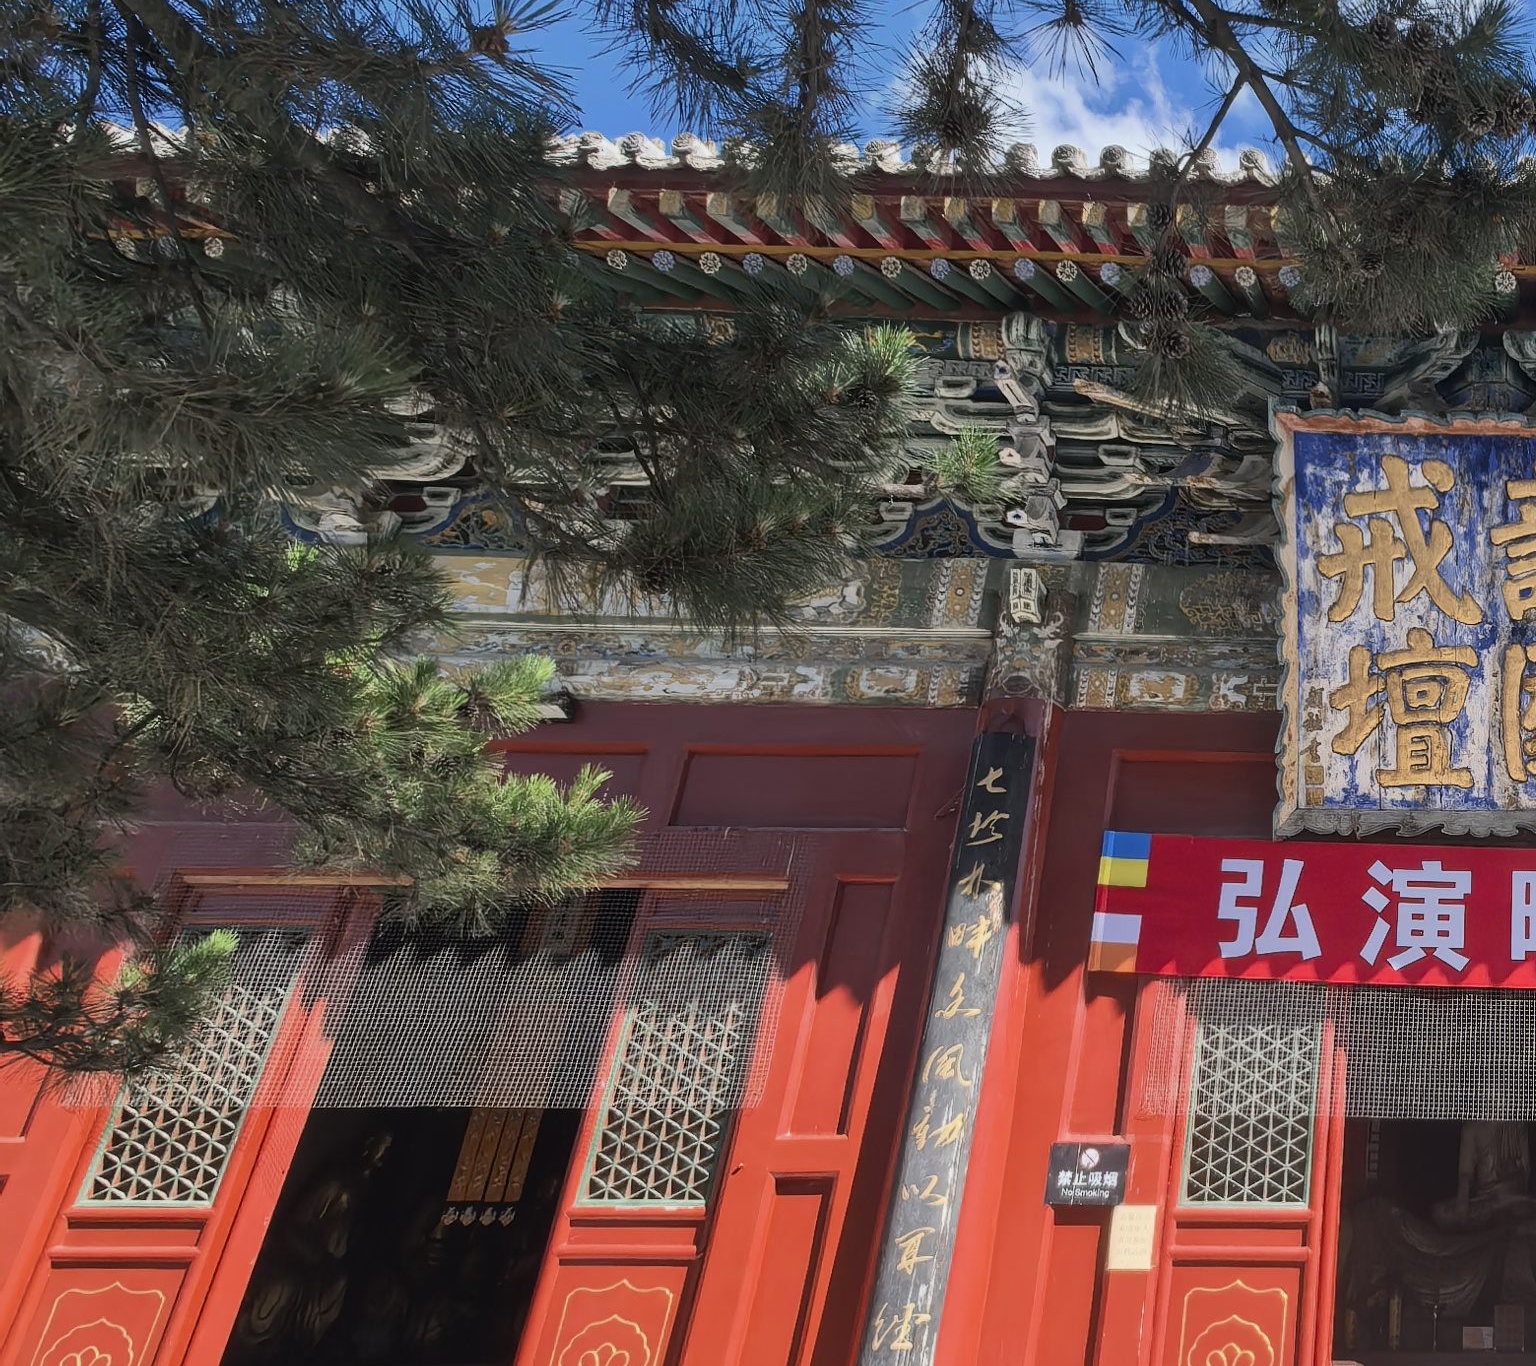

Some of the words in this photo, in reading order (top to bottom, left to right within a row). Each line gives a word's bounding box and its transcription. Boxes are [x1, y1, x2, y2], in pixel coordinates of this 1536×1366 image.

[1316, 453, 1483, 790] 戒壇
[1057, 1169, 1119, 1187] 禁止吸烟
[1061, 1188, 1073, 1196] No
[1074, 1188, 1110, 1198] Smoking
